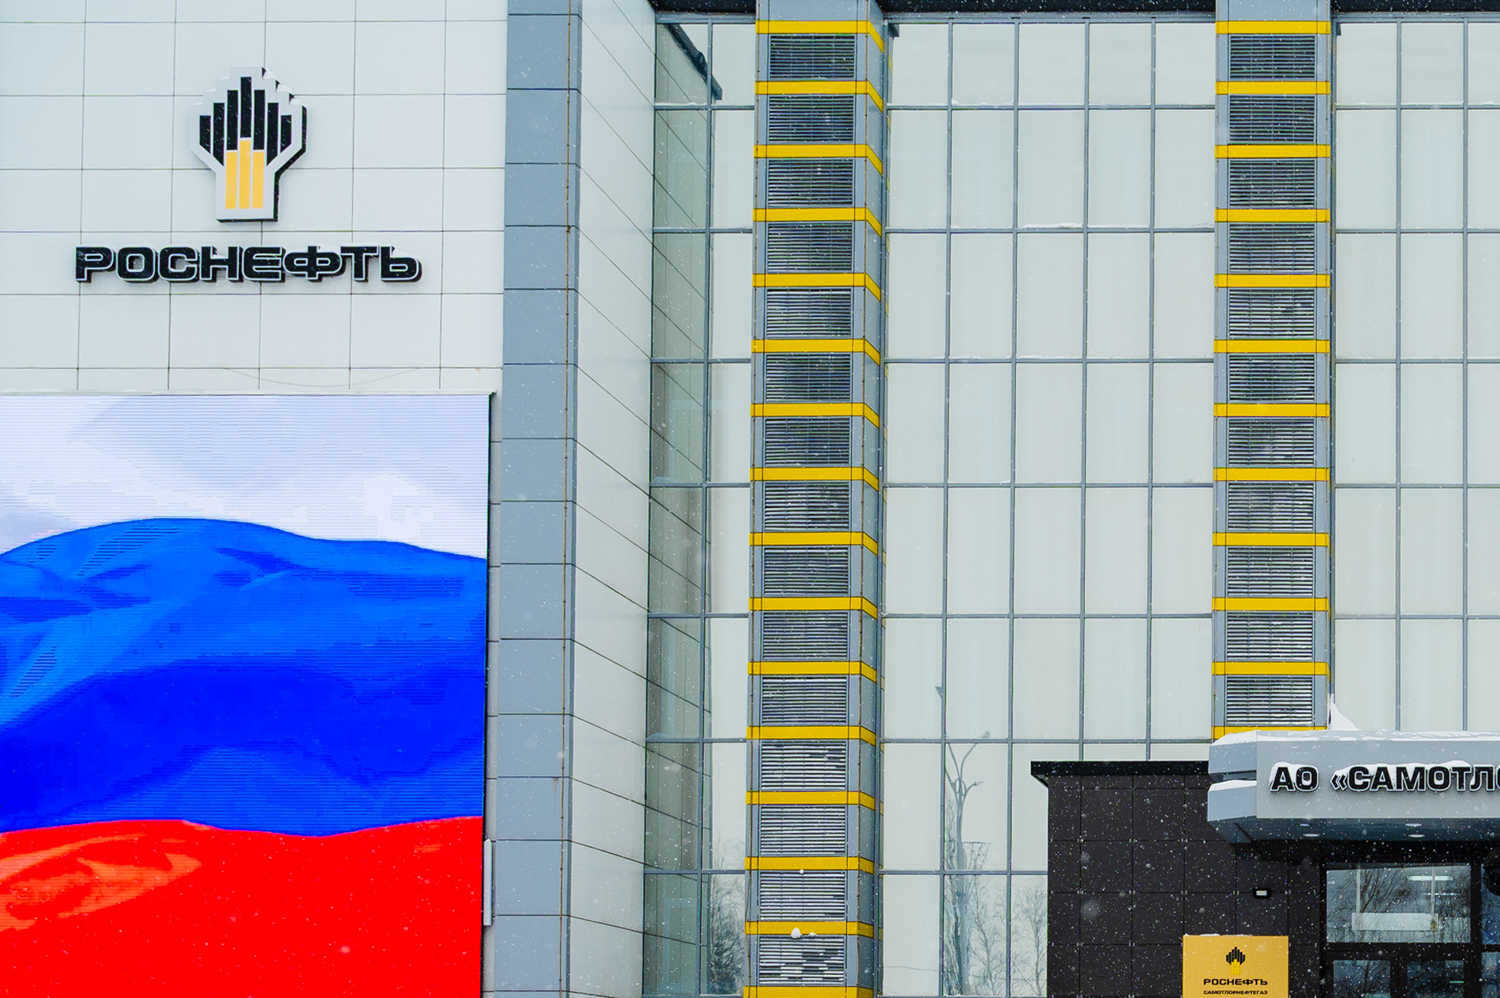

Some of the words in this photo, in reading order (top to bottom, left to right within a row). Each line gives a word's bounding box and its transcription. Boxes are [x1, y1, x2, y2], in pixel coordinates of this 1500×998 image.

[75, 245, 421, 282] РОСНЕФТЬ
[1270, 766, 1318, 792] АО
[1203, 978, 1268, 986] РОСНЕФТЬ
